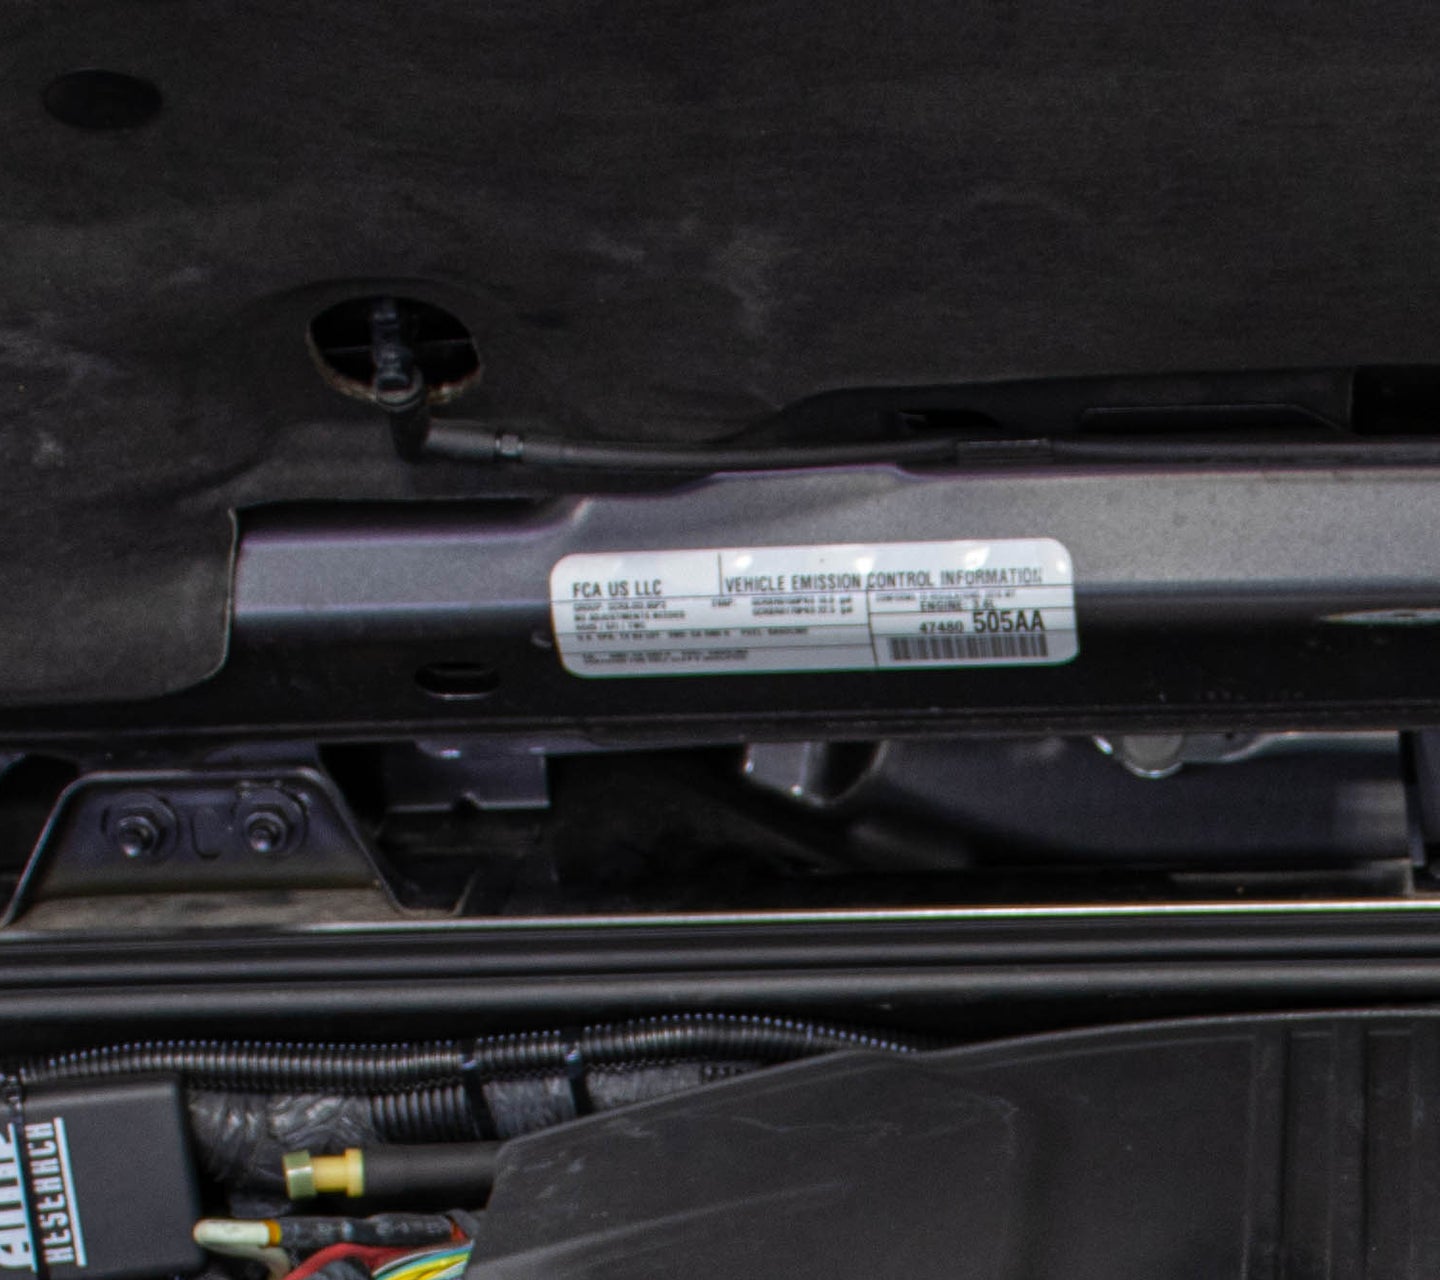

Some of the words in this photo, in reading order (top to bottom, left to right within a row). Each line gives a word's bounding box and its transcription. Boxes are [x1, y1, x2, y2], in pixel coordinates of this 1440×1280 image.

[573, 581, 601, 597] FCA
[610, 581, 629, 596] US
[635, 579, 661, 595] LLC
[725, 575, 785, 592] VEHICLE
[792, 573, 860, 591] EMISSION
[867, 570, 934, 587] CONTROL
[941, 567, 1042, 585] INFORMATION
[973, 609, 1045, 633] 505AA
[24, 1121, 76, 1266] RESEARCH
